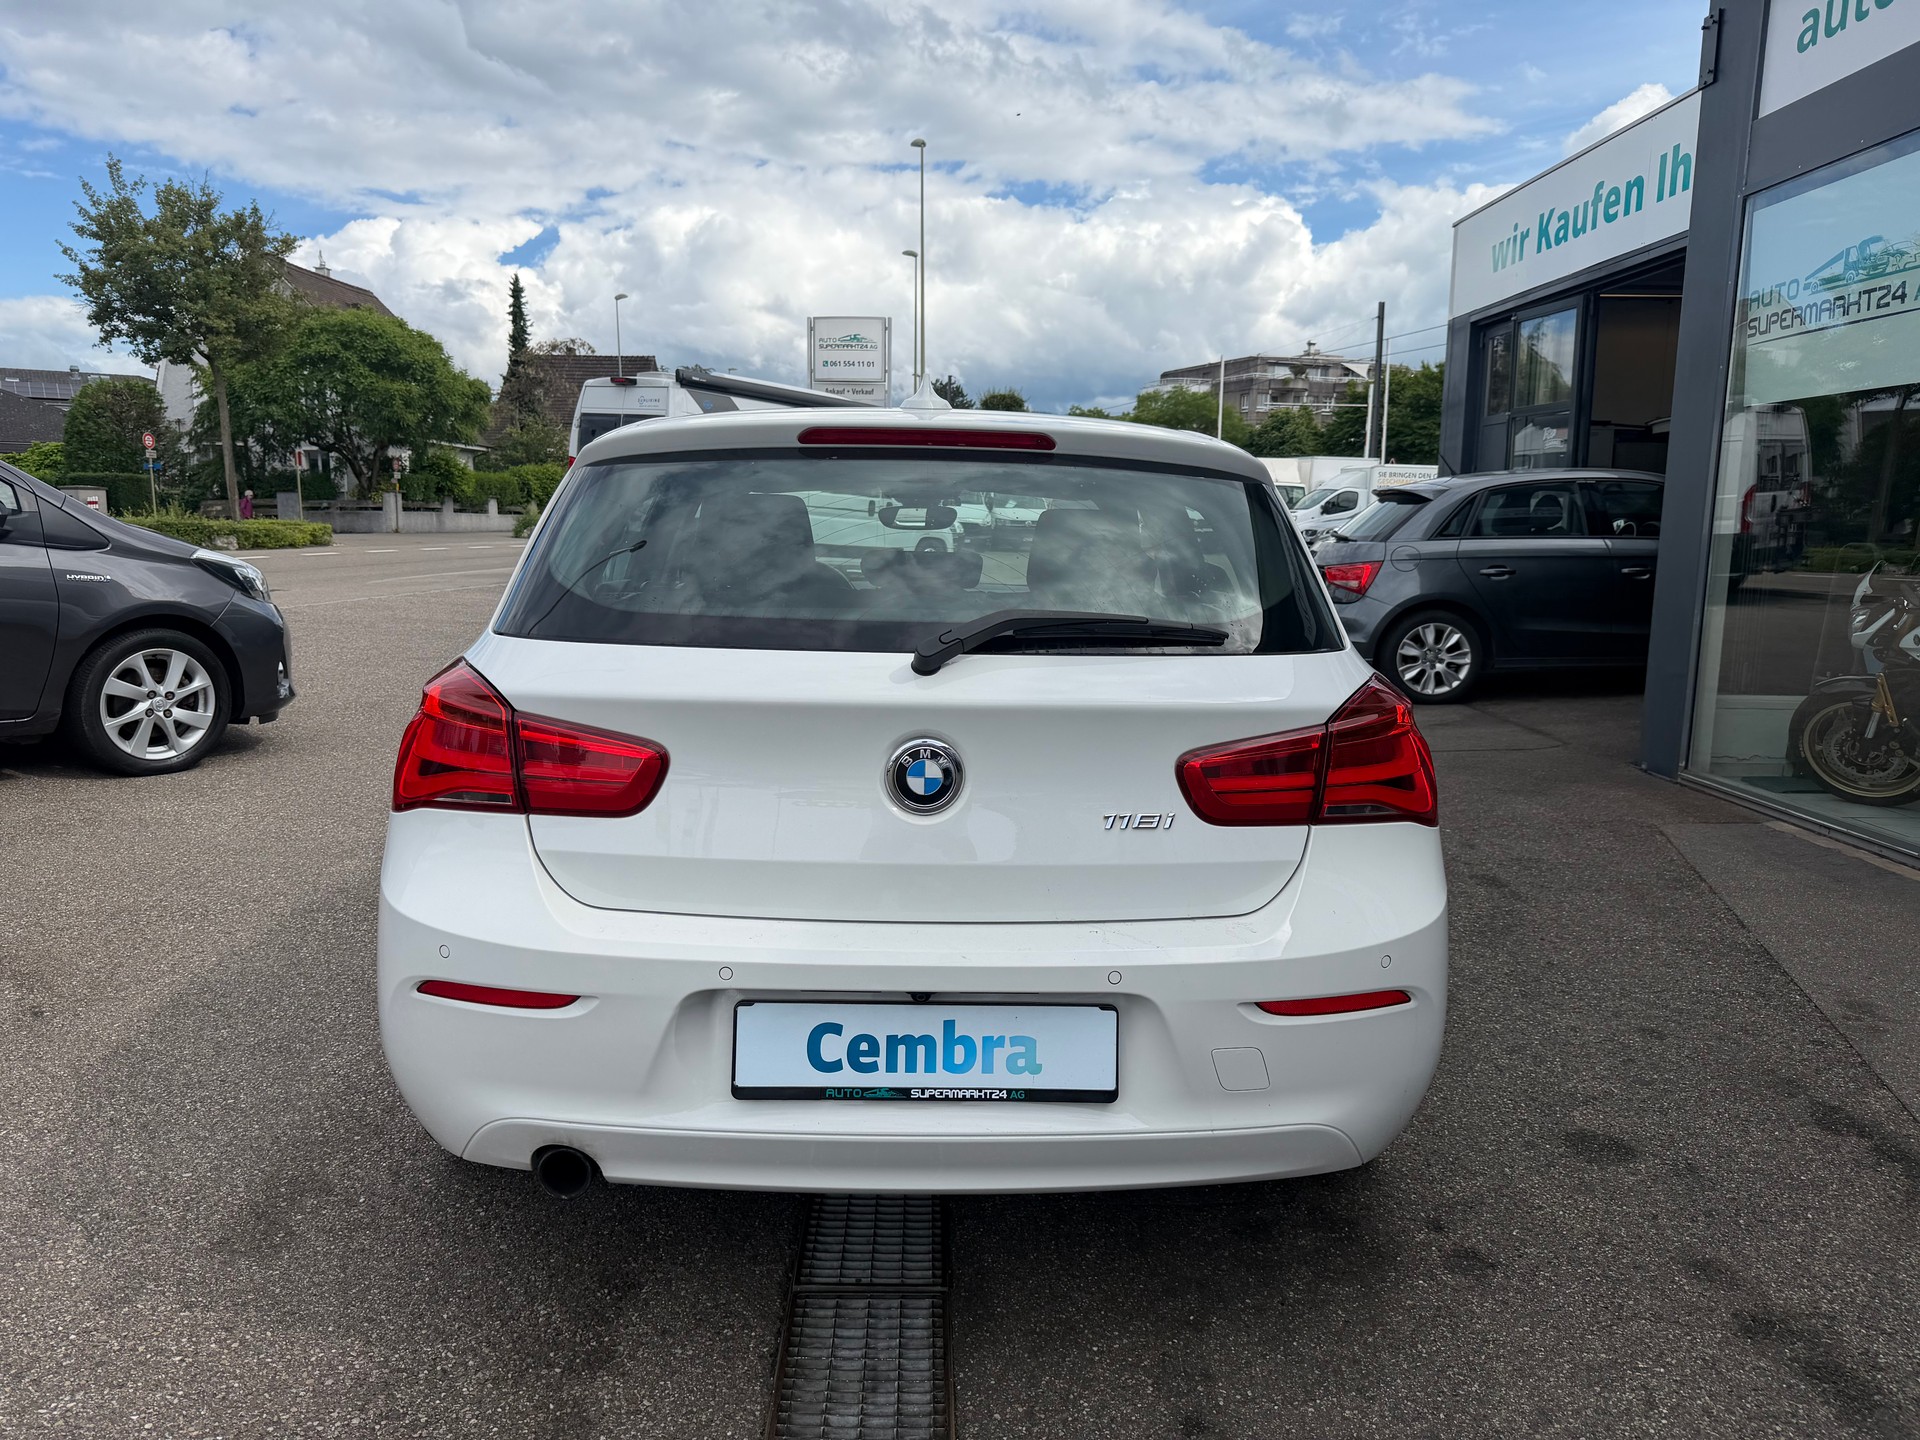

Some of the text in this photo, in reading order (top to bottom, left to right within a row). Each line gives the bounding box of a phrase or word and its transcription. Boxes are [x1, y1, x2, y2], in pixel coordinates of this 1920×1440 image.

[1796, 0, 1895, 53] au
[1491, 143, 1692, 273] wir Kaufen Ih
[1749, 278, 1800, 312] AUTO
[1747, 280, 1908, 339] SUPERMARKT24
[825, 387, 874, 395] Ankauf Verkauf
[66, 574, 104, 582] HYBRID
[900, 749, 950, 769] BMW
[1103, 812, 1176, 830] 118i
[806, 1019, 1043, 1076] Cembra
[825, 1088, 1026, 1100] AUTO SUPERMARKT24 AG
